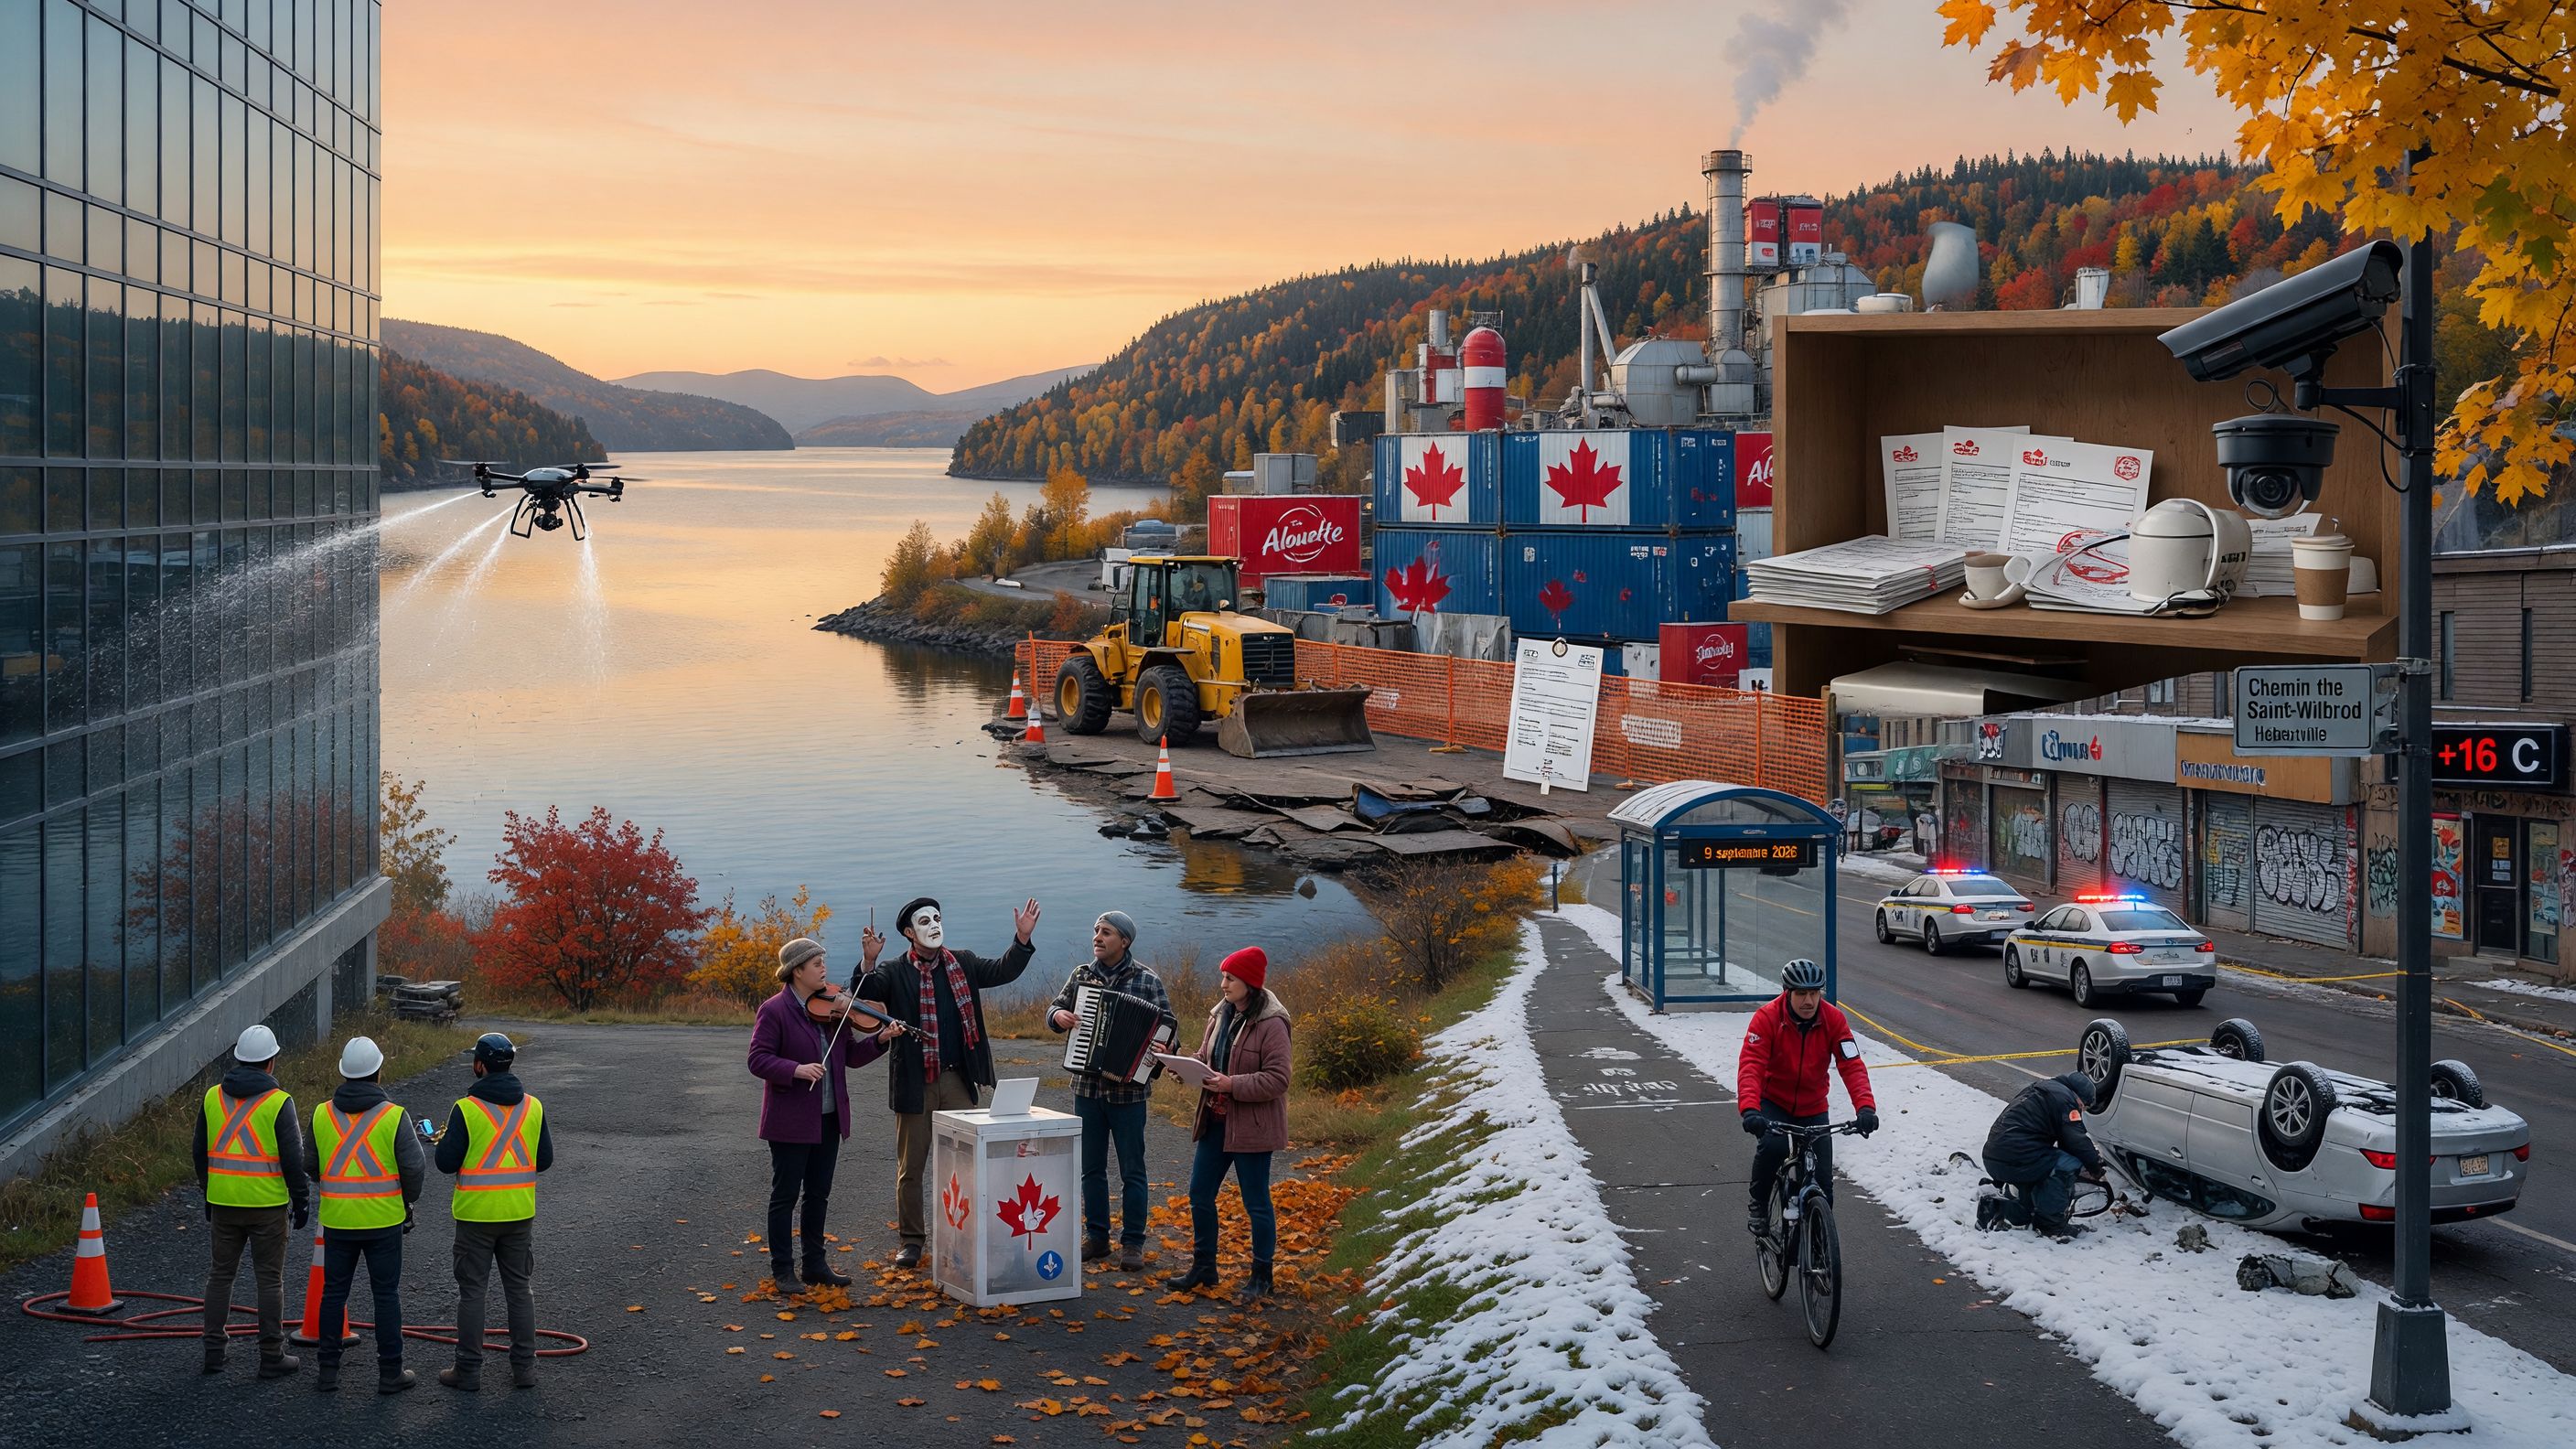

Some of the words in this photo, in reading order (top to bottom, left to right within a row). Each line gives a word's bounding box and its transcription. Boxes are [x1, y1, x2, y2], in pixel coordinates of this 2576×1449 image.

[1261, 519, 1344, 556] Alouette
[2249, 678, 2310, 696] Chemin
[2317, 677, 2344, 696] the
[2248, 701, 2362, 719] Saint-Wilbrod
[2438, 737, 2497, 772] +16
[2512, 737, 2540, 773] C
[1704, 846, 1712, 859] 9
[1772, 845, 1798, 858] 2026
